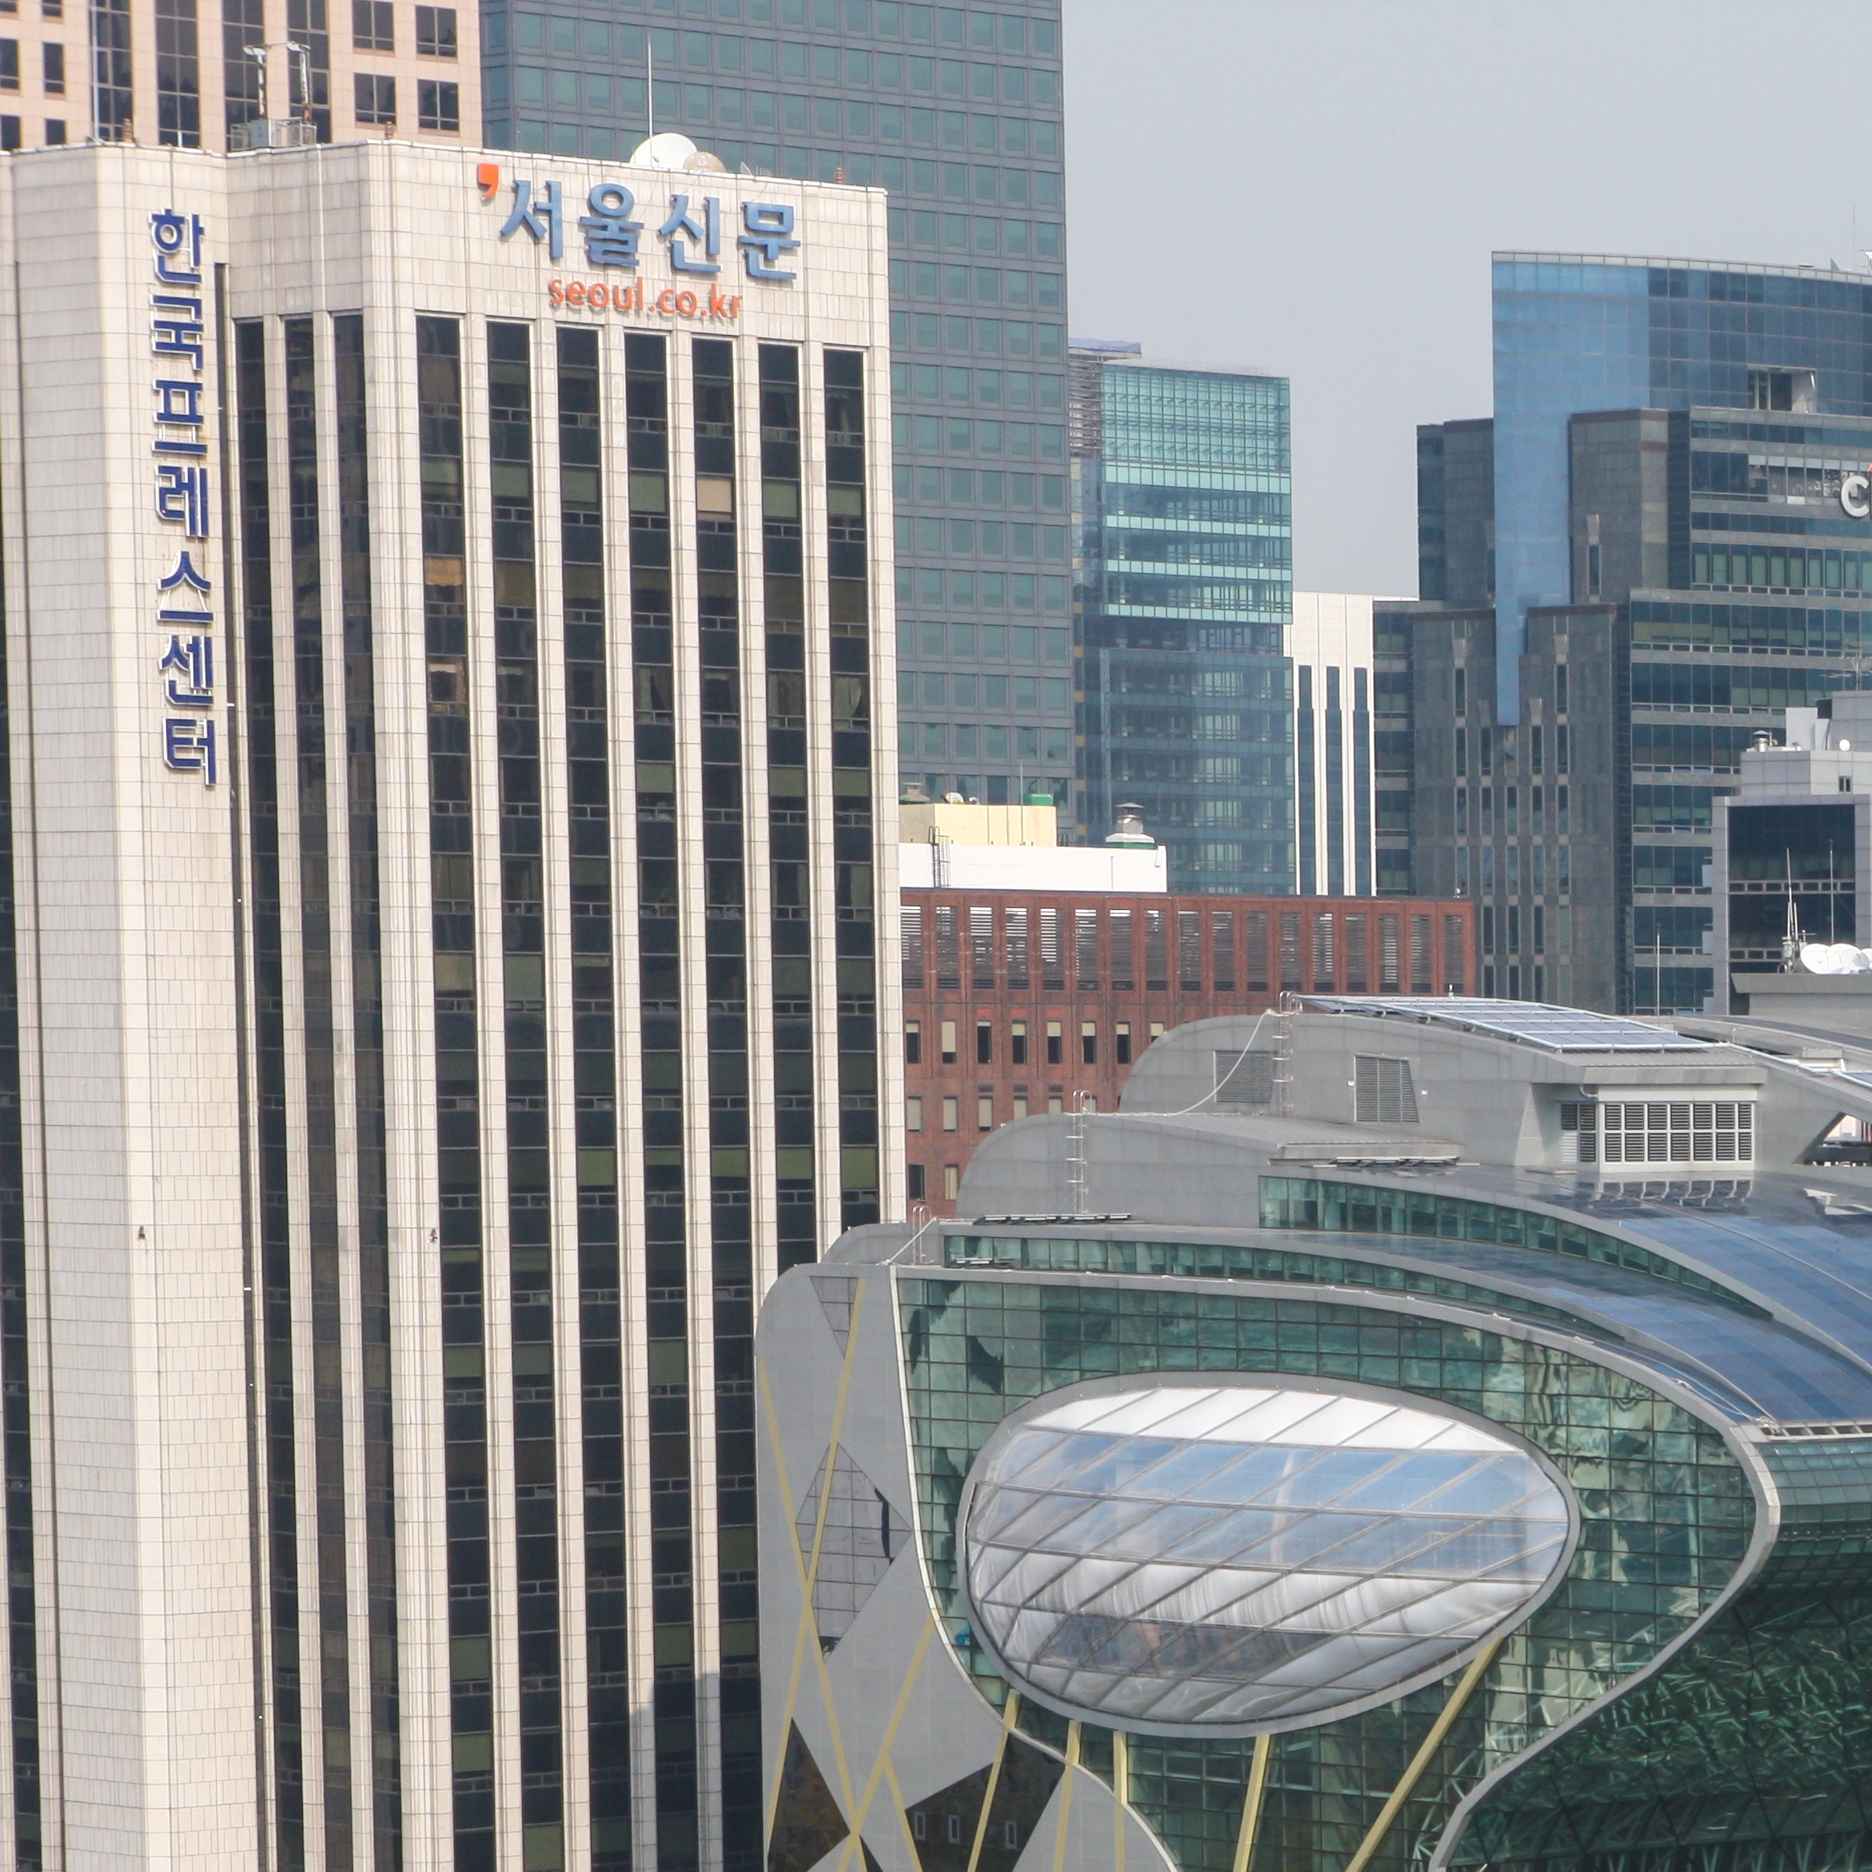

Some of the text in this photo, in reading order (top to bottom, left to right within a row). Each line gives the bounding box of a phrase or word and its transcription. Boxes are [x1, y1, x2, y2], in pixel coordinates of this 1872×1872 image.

[500, 180, 801, 282] 서울신문
[548, 276, 744, 321] seoul.co.kr
[149, 208, 217, 787] 한국프레스센터
